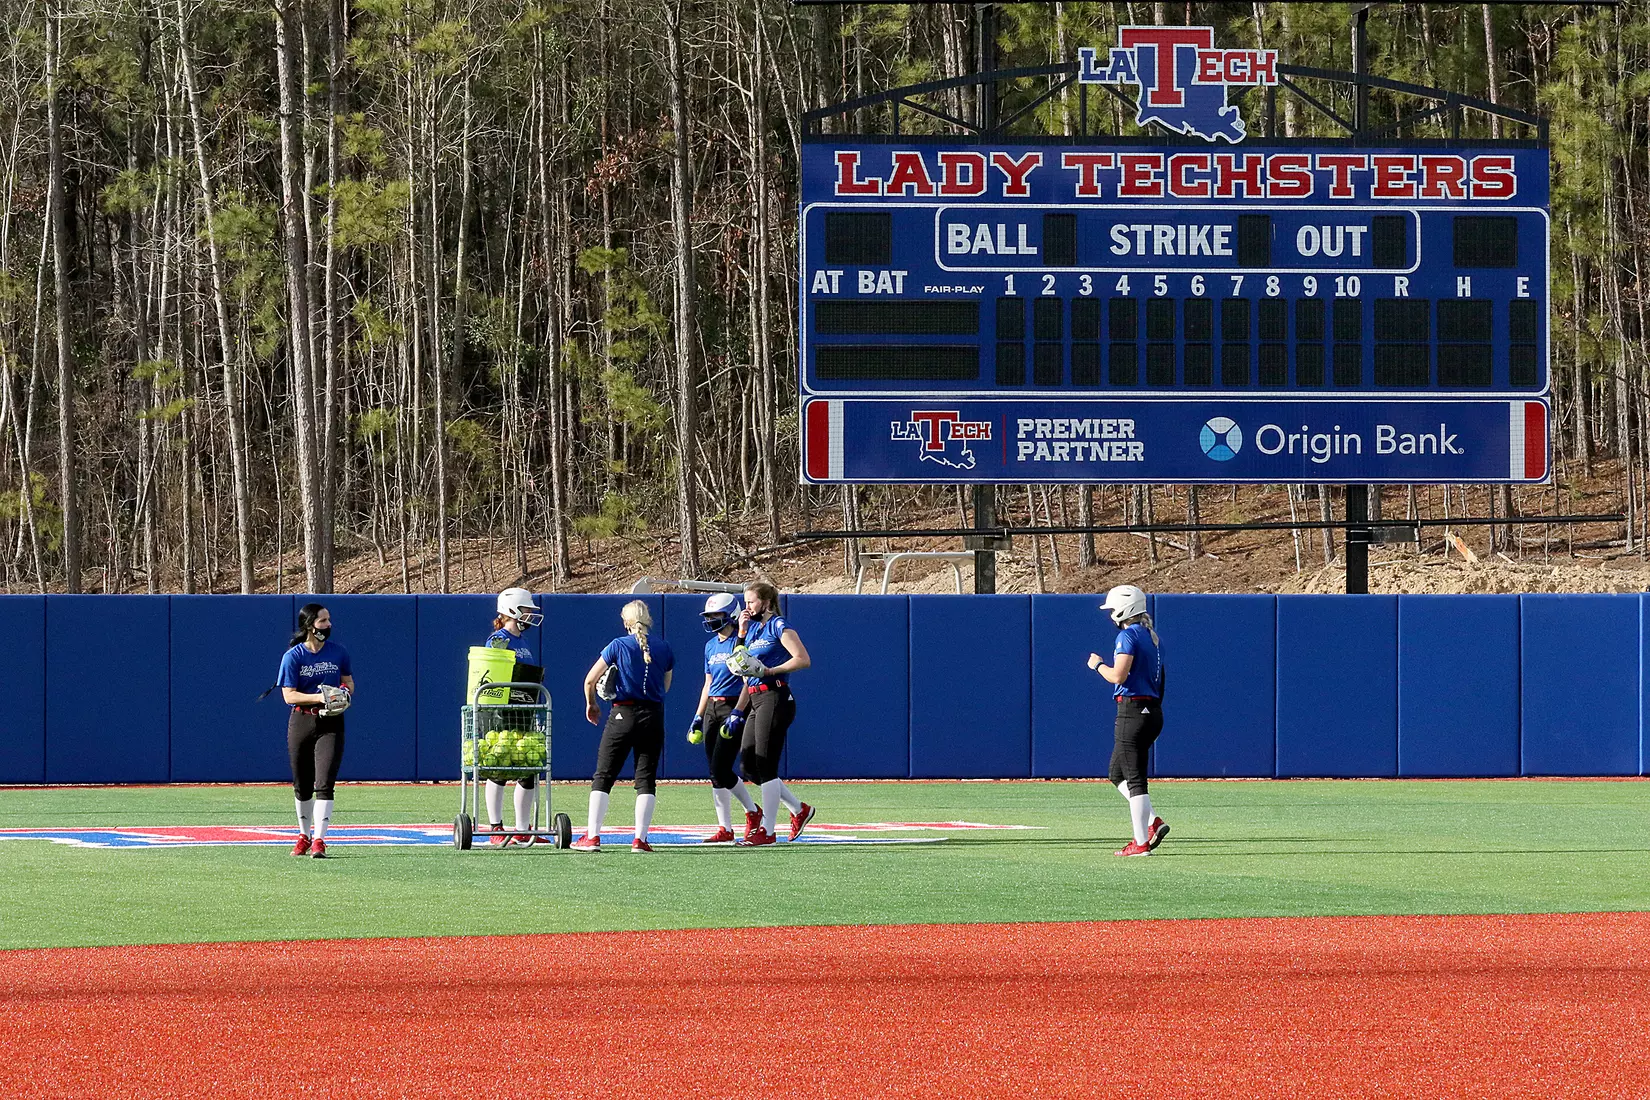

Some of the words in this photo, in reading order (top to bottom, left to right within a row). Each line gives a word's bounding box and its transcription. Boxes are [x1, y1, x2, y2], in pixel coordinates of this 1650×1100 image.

[1078, 47, 1138, 84] LA
[1118, 25, 1279, 108] TECH
[834, 150, 1044, 198] LADY
[1060, 152, 1518, 200] TECHSTERS
[947, 223, 1038, 255] BALL
[1109, 223, 1233, 256] STRIKE
[1296, 225, 1368, 257] OUT
[811, 270, 844, 294] AT
[858, 270, 908, 294] BAT
[924, 285, 985, 294] FAIR-PLAY
[1005, 274, 1016, 296] 1
[1042, 274, 1055, 296] 2
[1079, 274, 1093, 296] 3
[1116, 274, 1130, 296] 4
[1155, 274, 1168, 296] 5
[1191, 275, 1205, 296] 6
[1231, 275, 1244, 296] 7
[1266, 275, 1280, 297] 8
[1304, 275, 1318, 297] 9
[1334, 275, 1361, 297] 10
[1394, 276, 1409, 297] R
[1457, 276, 1471, 297] H
[1516, 276, 1530, 297] E
[1017, 418, 1135, 439] PREMIER
[1255, 424, 1362, 464] Origin
[1376, 423, 1459, 455] Bank
[1017, 441, 1144, 462] PARTNER
